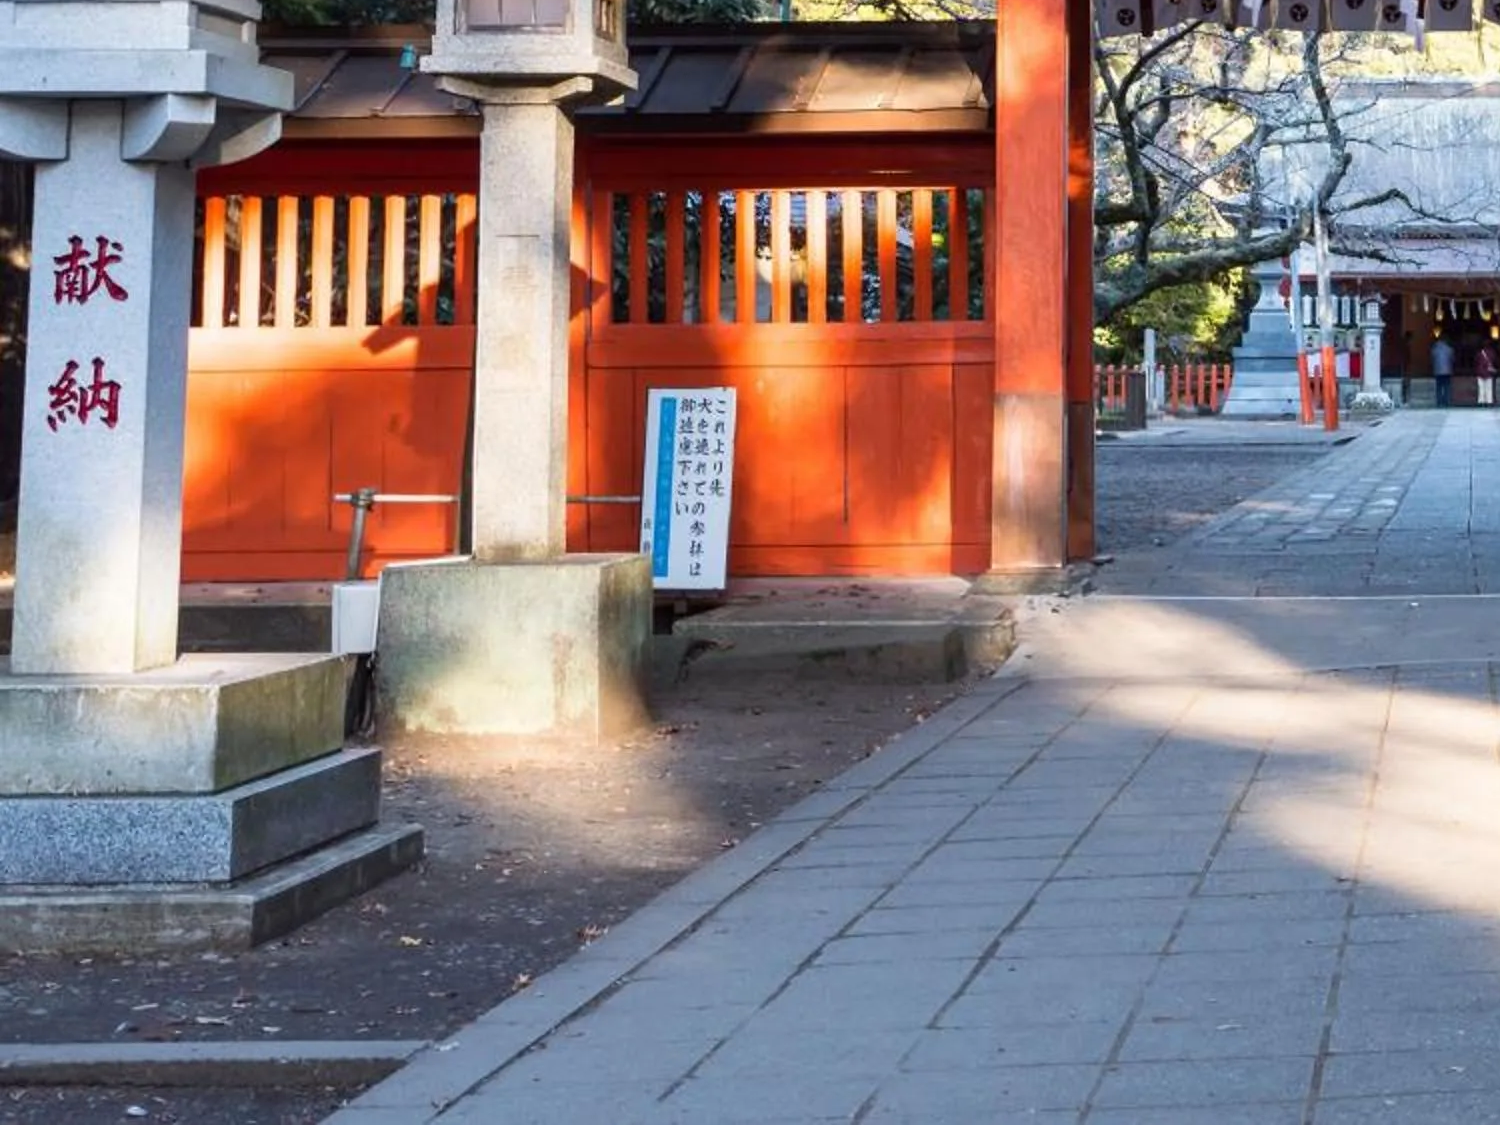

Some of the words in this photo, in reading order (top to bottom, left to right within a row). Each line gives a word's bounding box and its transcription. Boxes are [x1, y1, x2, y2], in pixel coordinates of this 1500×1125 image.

[47, 235, 129, 433] 献納
[675, 398, 696, 515] 御遠慮下さい
[689, 398, 712, 576] 犬を連れての参拝は
[711, 398, 726, 497] これより先
